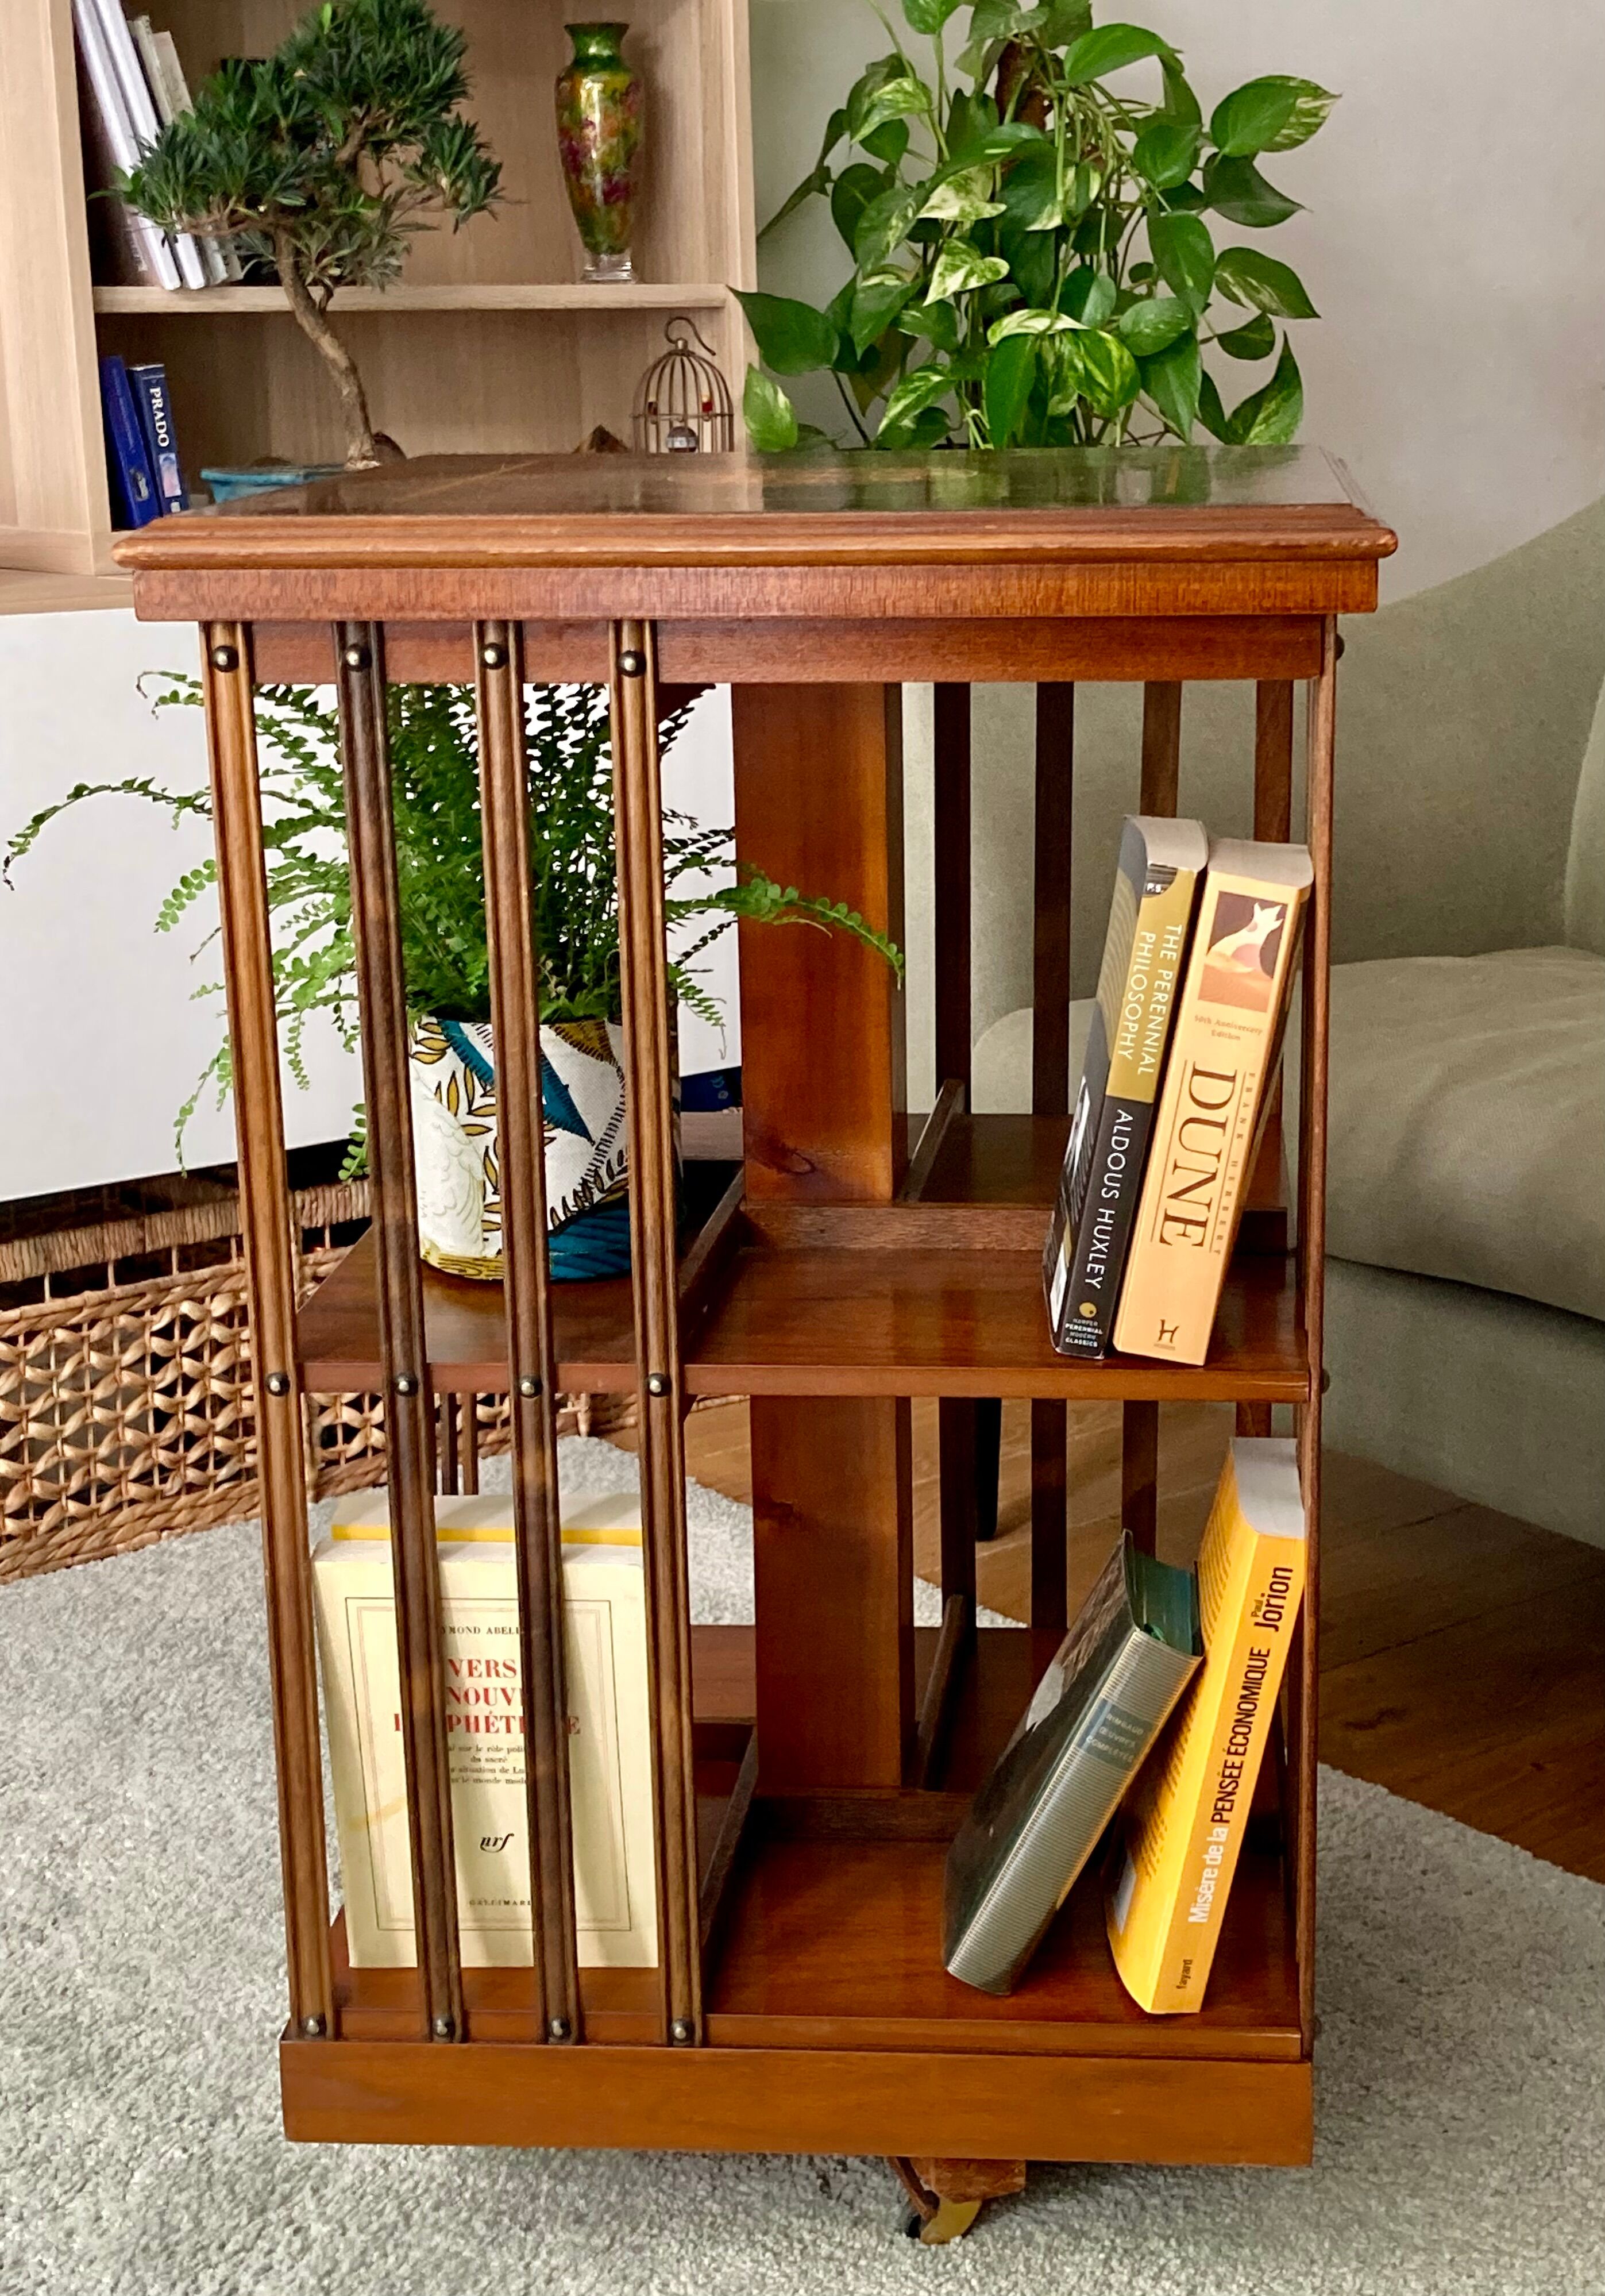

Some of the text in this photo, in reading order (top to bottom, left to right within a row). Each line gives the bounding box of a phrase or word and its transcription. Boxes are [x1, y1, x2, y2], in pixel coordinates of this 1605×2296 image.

[150, 387, 170, 448] PRADO
[1117, 931, 1156, 1061] PHILOSOPHY
[1137, 924, 1182, 1076] THE PERENNIAL
[1159, 1061, 1238, 1247] DUNE
[1213, 1072, 1256, 1255] FRANK HERBERT
[1085, 1109, 1134, 1289] ALDOUS HUXLEY
[1065, 1336, 1098, 1348] CLASSICS
[1251, 1598, 1264, 1618] Paul
[1253, 1566, 1294, 1632] Jorion
[446, 1686, 524, 1707] NOUV
[448, 1658, 518, 1679] VERS
[1187, 1646, 1271, 1923] Misère de la PENSÉE ÉCONOMIQUE
[480, 1832, 515, 1853] nrf
